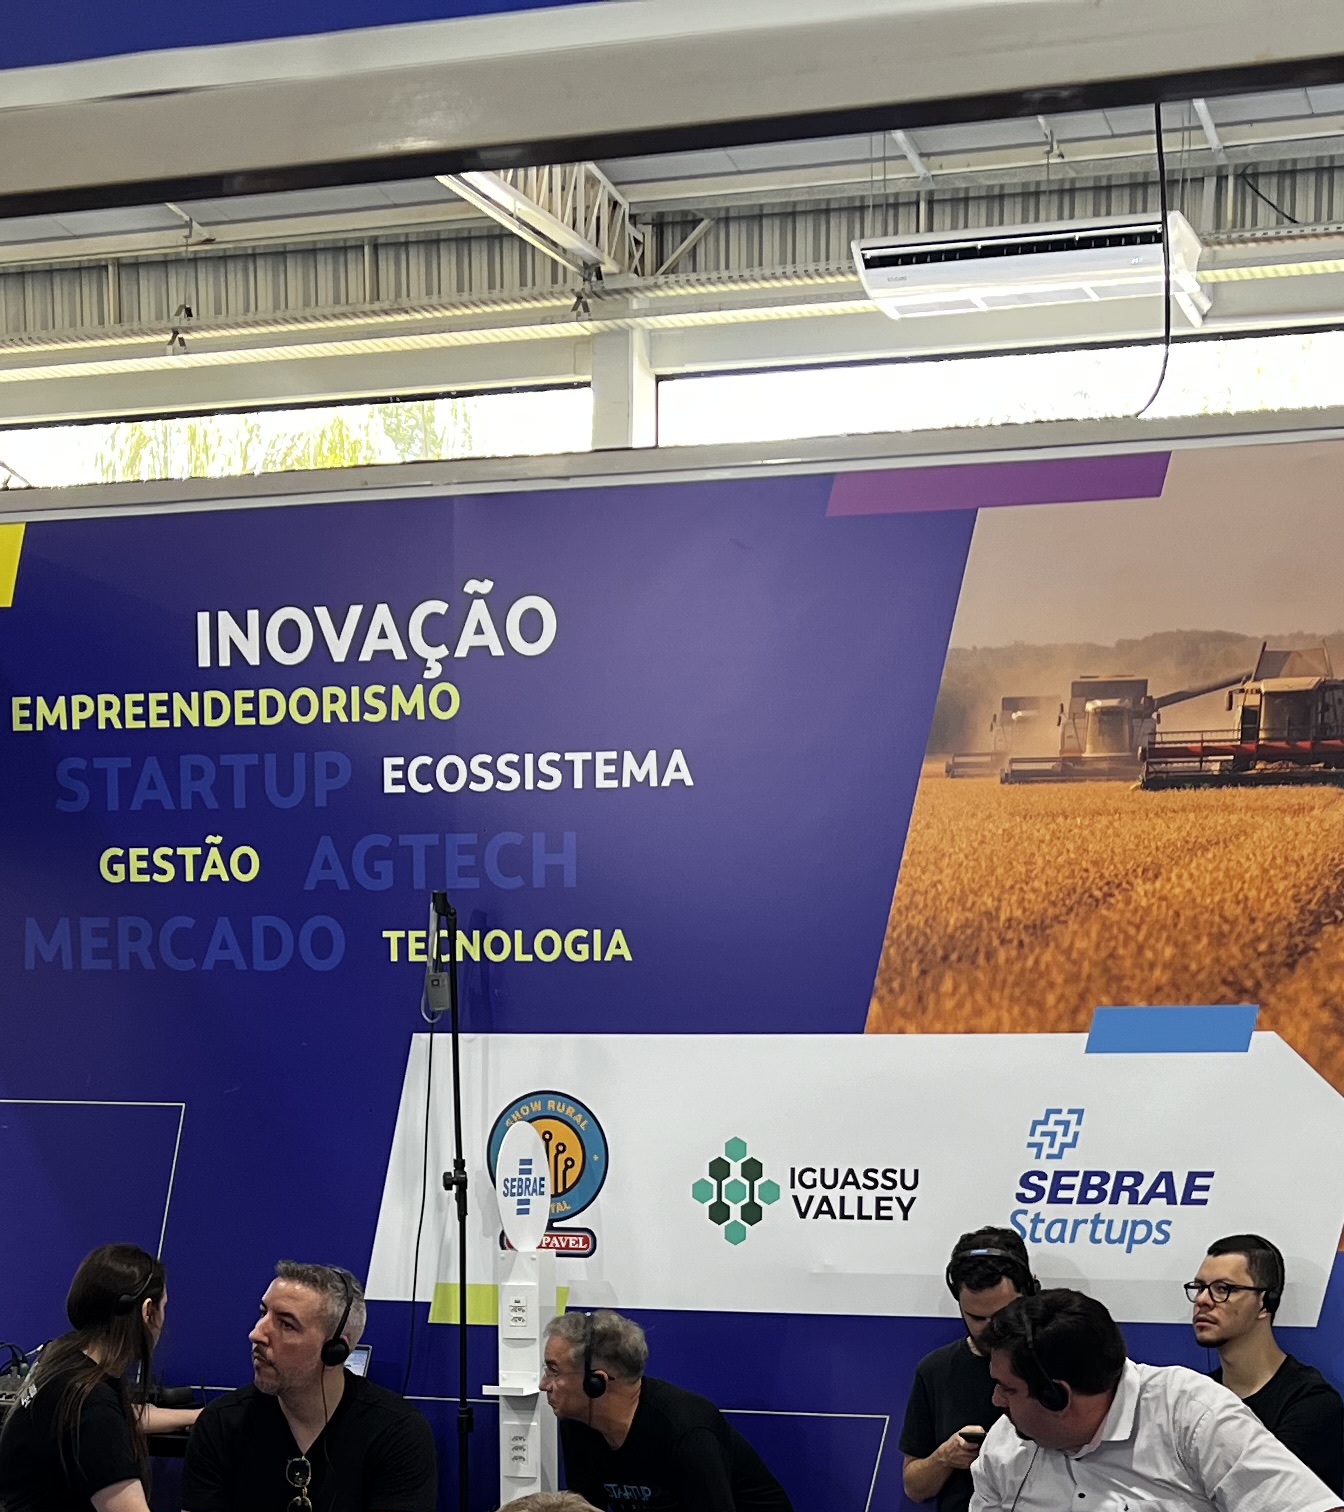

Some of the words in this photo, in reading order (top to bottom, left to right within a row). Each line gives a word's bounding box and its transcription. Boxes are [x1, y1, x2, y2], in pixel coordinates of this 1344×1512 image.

[196, 579, 557, 679] INOVAÇÃO
[11, 682, 460, 731] EMPREENDEDORISMO
[56, 750, 353, 812] STARTUP
[383, 749, 694, 793] ECOSSISTEMA
[100, 835, 260, 883] GESTÃO
[303, 831, 578, 891] AGTECH
[23, 915, 346, 971] MERCADO
[547, 1100, 590, 1131] RURAL
[503, 1177, 545, 1197] SEBRAE
[790, 1167, 919, 1191] IGUASSU
[1015, 1170, 1215, 1205] SEBRAE
[792, 1195, 916, 1221] VALLEY
[541, 1235, 588, 1248] PAVEL
[1010, 1209, 1172, 1253] Startups
